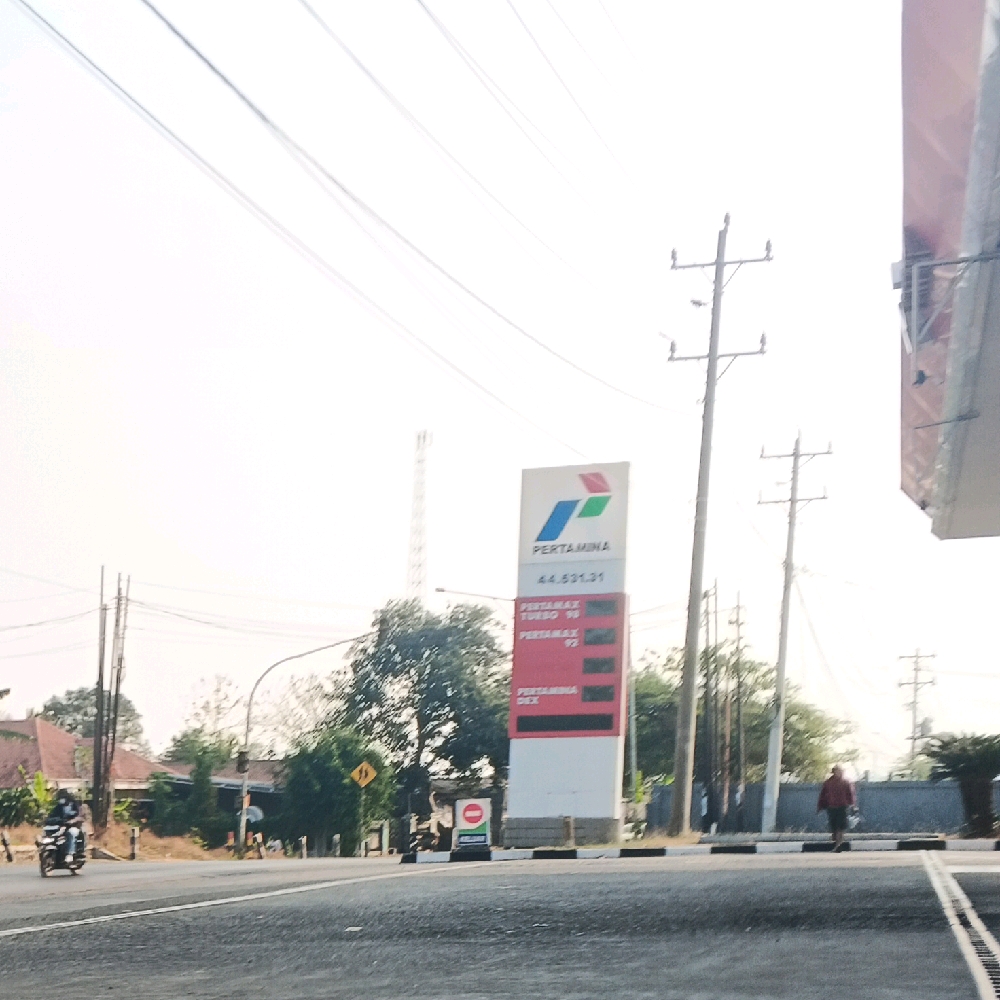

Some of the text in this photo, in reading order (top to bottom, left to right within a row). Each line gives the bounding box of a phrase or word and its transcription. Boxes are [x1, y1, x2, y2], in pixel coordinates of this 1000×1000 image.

[533, 542, 610, 554] PERTAMINA
[521, 601, 580, 611] PERTAMAX
[521, 611, 559, 620] TURBO
[519, 629, 578, 639] PERTAMAX
[517, 696, 539, 705] DEX
